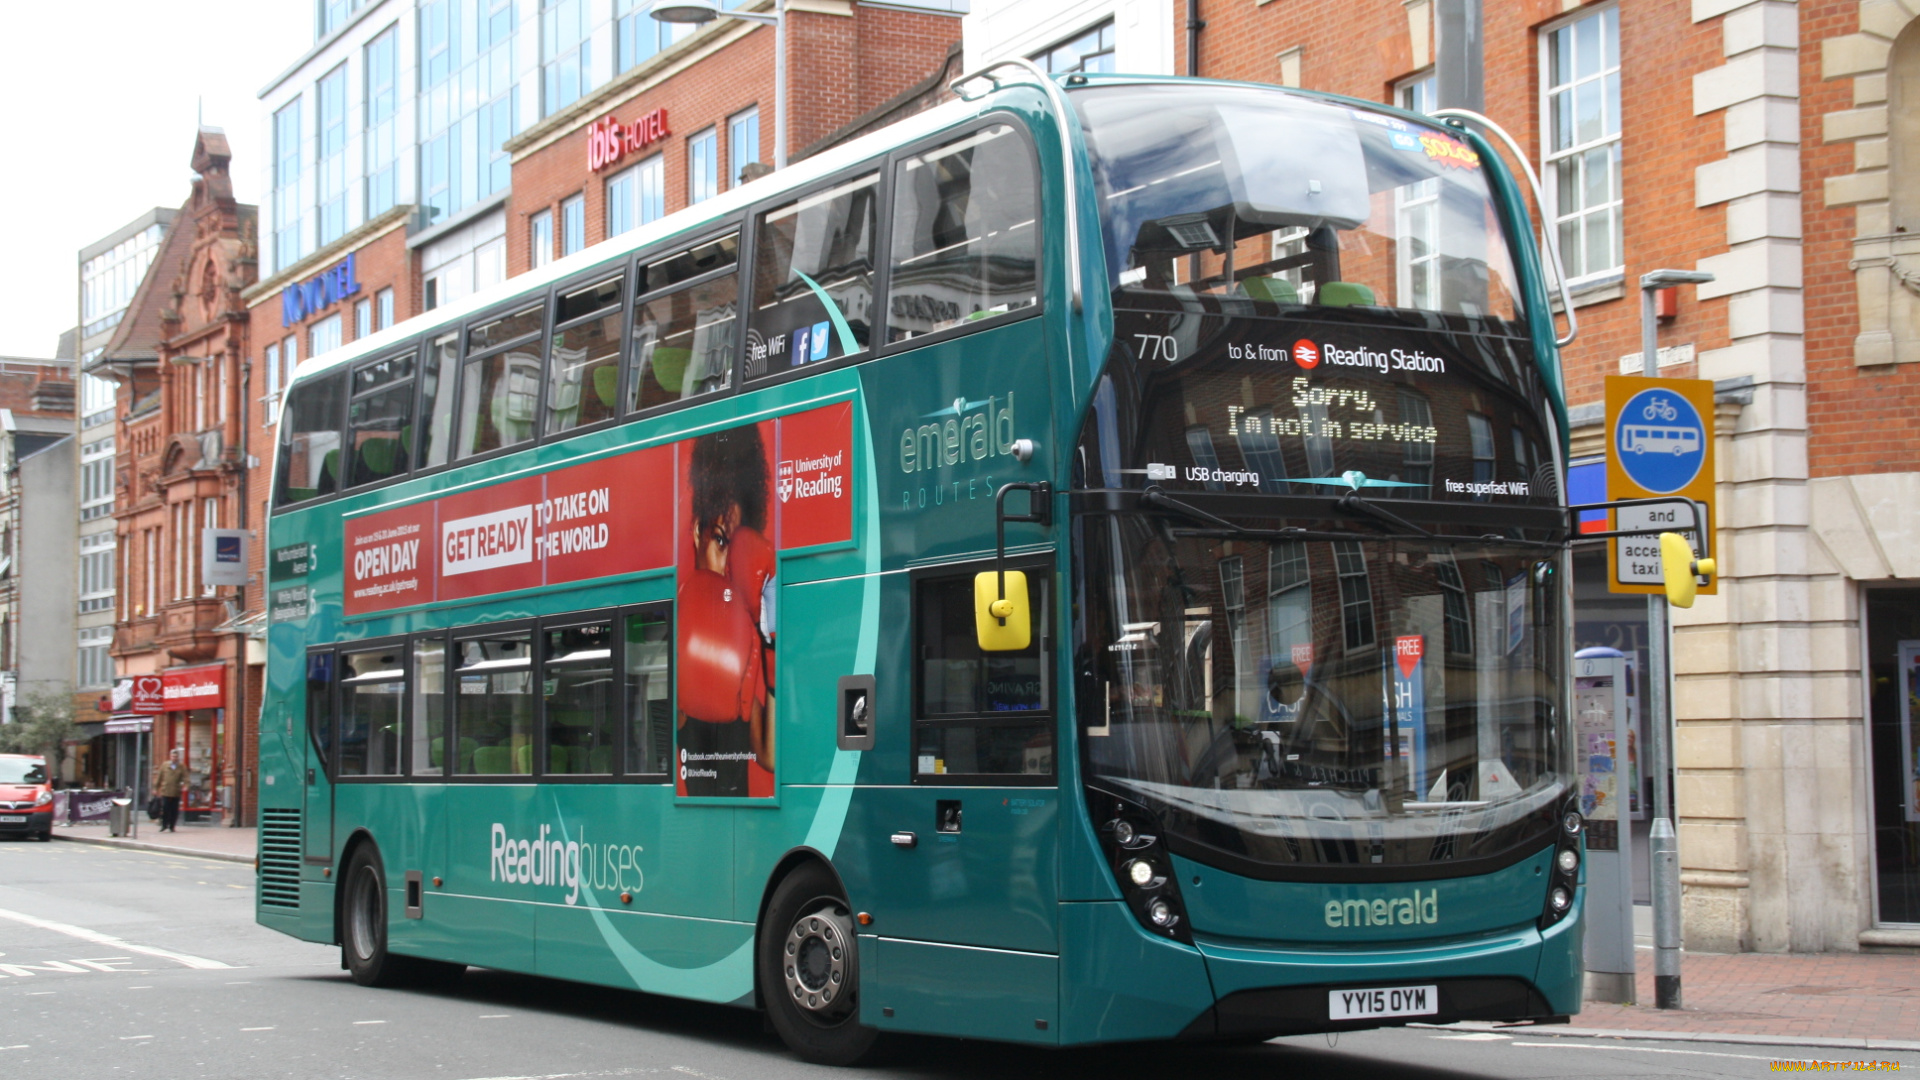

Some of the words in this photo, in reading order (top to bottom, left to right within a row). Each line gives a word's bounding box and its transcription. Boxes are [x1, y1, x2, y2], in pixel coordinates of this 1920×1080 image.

[588, 115, 621, 172] ibis
[625, 109, 669, 154] HOTEL
[1394, 133, 1415, 147] GO
[282, 252, 362, 329] NOVOTEL
[752, 342, 767, 361] free
[768, 334, 786, 356] WiFi
[1133, 334, 1178, 362] 770
[1228, 343, 1242, 359] to
[1245, 344, 1257, 360] &
[1259, 344, 1288, 362] from
[1324, 344, 1389, 374] Reading
[1390, 349, 1445, 373] Station
[1292, 377, 1376, 411] Sorry,
[901, 391, 1014, 473] emerald
[1228, 405, 1262, 436] I'm
[1270, 413, 1313, 437] not
[1322, 417, 1342, 438] in
[1350, 422, 1438, 443] service
[795, 454, 833, 473] University
[834, 449, 842, 466] of
[795, 472, 842, 499] Reading
[1186, 466, 1210, 482] USB
[1212, 468, 1259, 487] charging
[1446, 478, 1466, 493] free
[1466, 480, 1509, 496] superfast
[1509, 481, 1530, 496] WiFi
[535, 499, 553, 527] TO
[554, 492, 587, 522] TAKE
[588, 487, 609, 516] ON
[903, 475, 993, 511] ROUTES
[1649, 509, 1674, 521] and
[446, 528, 475, 563] GET
[478, 517, 528, 558] READY
[535, 531, 559, 560] THE
[561, 523, 609, 554] WORLD
[310, 544, 317, 570] 5
[354, 545, 390, 580] OPEN
[391, 539, 420, 573] DAY
[310, 588, 316, 614] 6
[1291, 646, 1311, 662] FREE
[1397, 640, 1420, 655] FREE
[1325, 888, 1438, 927] emerald
[1342, 991, 1385, 1014] YY15
[1390, 989, 1426, 1011] OYM
